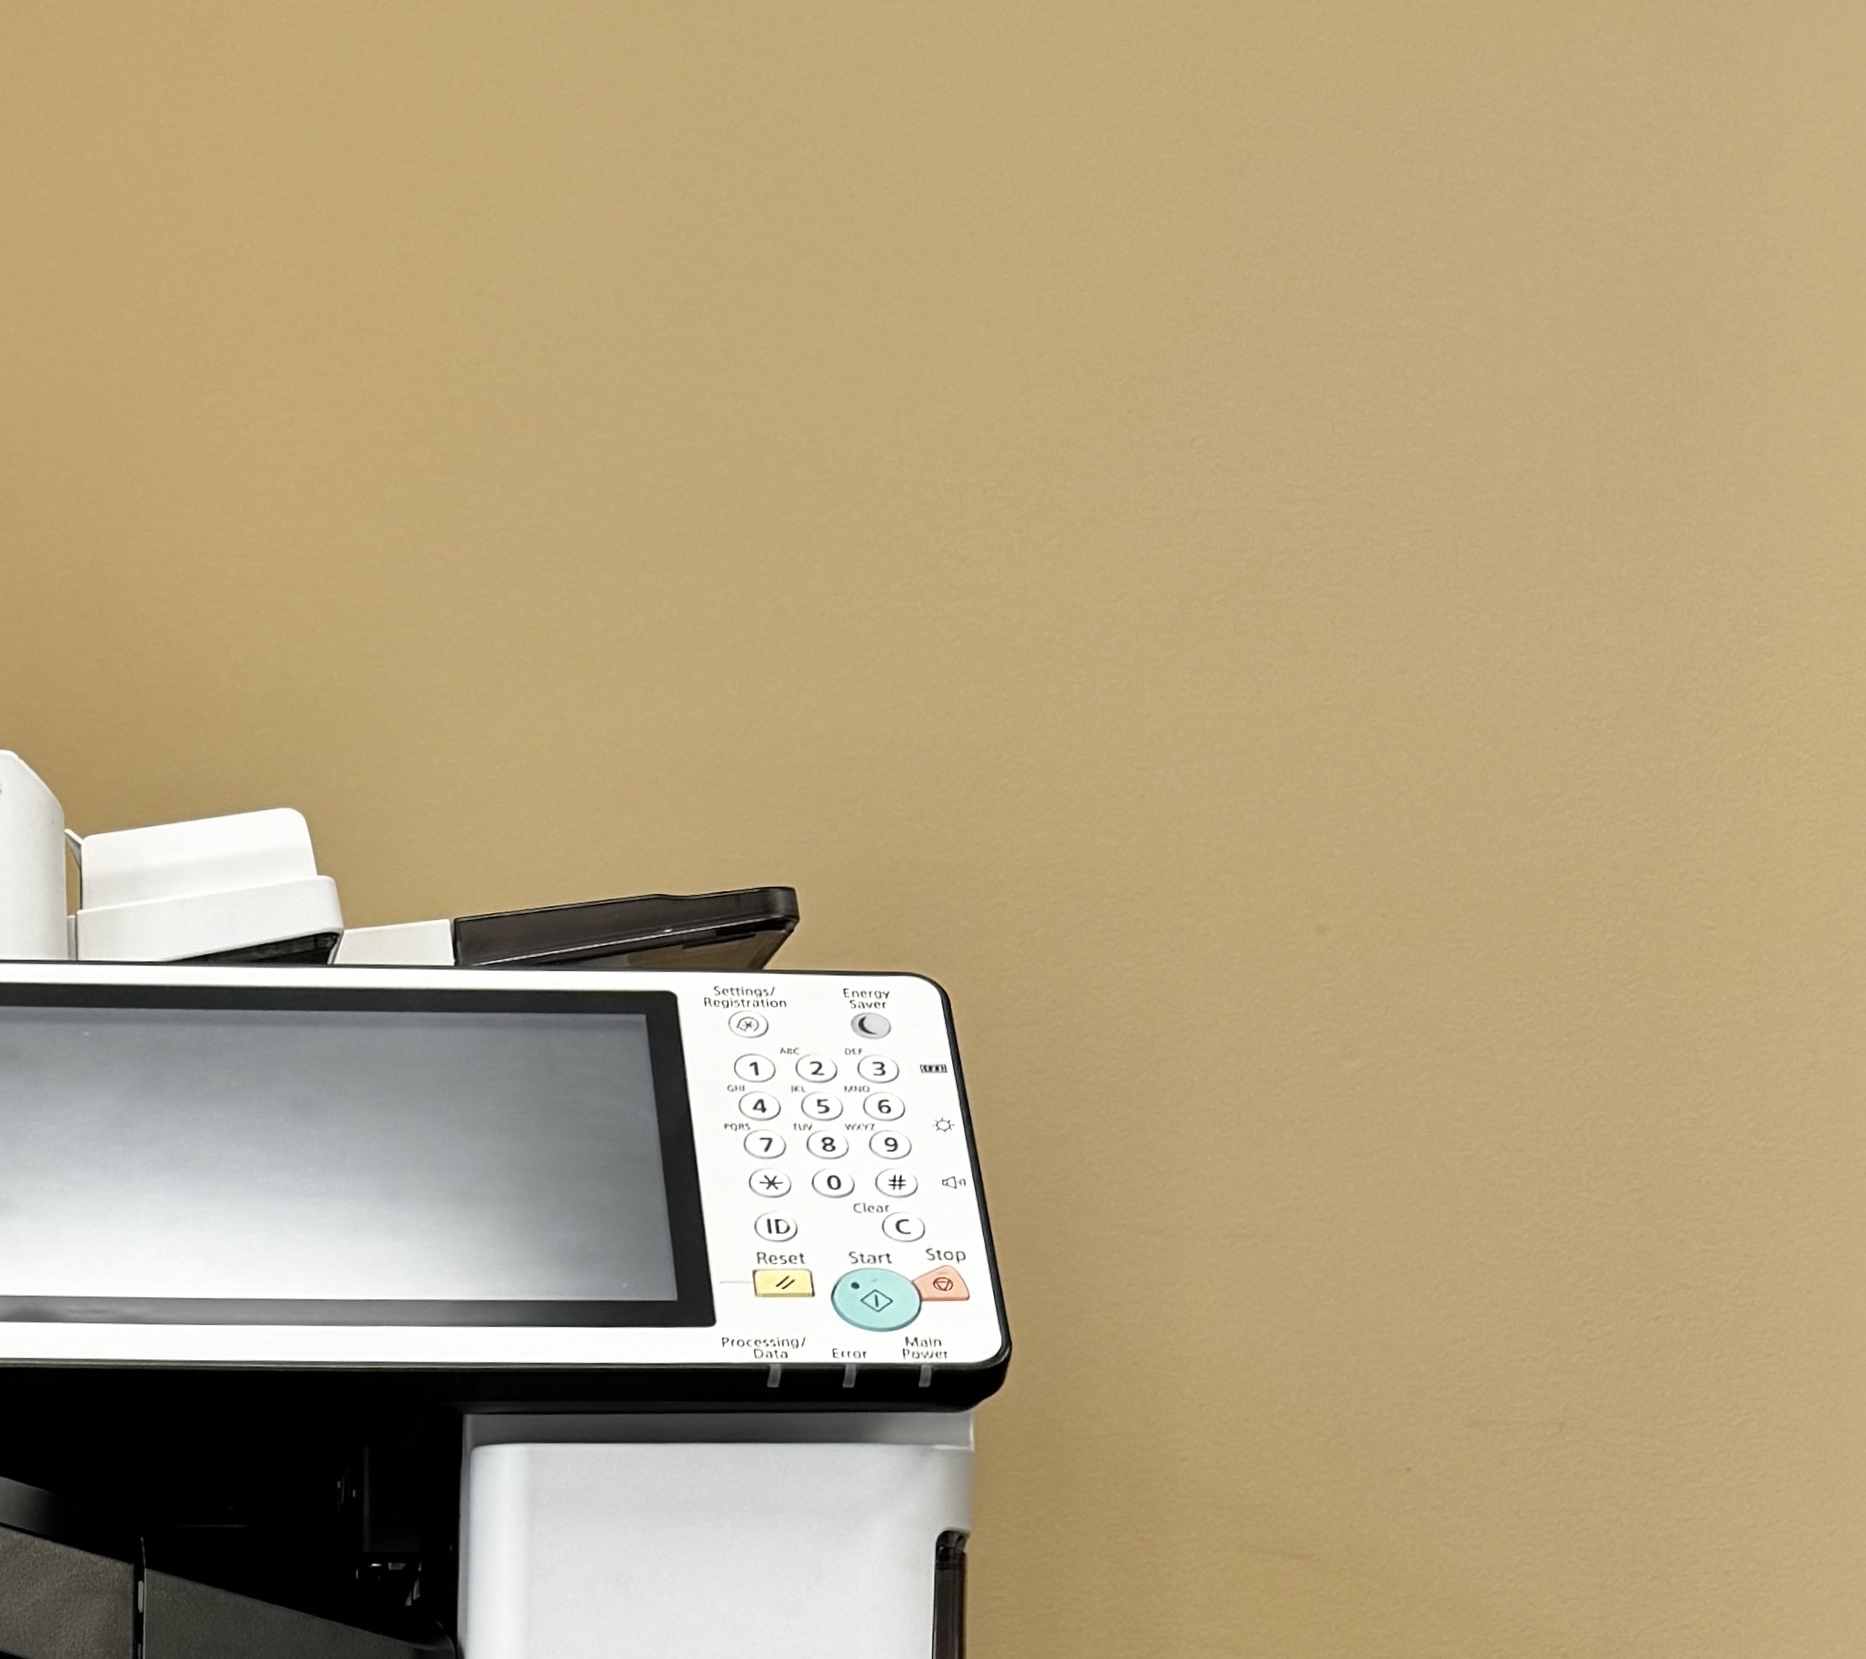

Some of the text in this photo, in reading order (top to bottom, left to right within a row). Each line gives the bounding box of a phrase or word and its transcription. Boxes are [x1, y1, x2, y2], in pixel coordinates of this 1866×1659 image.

[713, 985, 775, 998] Settings/
[842, 987, 890, 1000] Energy
[703, 996, 787, 1009] Registration
[849, 999, 886, 1009] Saver
[779, 1047, 799, 1055] ABC
[844, 1047, 862, 1056] DEF
[749, 1061, 760, 1077] 1
[809, 1060, 825, 1076] 2
[872, 1061, 887, 1077] 3
[726, 1084, 746, 1093] GHI
[843, 1085, 870, 1093] MNO
[752, 1098, 767, 1114] 4
[816, 1098, 831, 1115] 5
[877, 1098, 892, 1115] 6
[723, 1122, 751, 1132] PQRS
[793, 1122, 813, 1131] TUV
[759, 1137, 774, 1153] 7
[820, 1136, 837, 1153] 8
[884, 1136, 899, 1153] 9
[826, 1174, 842, 1191] 0
[853, 1202, 890, 1214] Clear
[766, 1218, 791, 1235] ID
[894, 1218, 912, 1235] C
[756, 1251, 805, 1265] Reset
[848, 1251, 893, 1265] Start
[925, 1247, 967, 1264] Stop
[721, 1336, 806, 1350] Processing/
[904, 1336, 942, 1347] Main
[753, 1348, 789, 1359] Data
[831, 1347, 867, 1359] Error
[902, 1347, 948, 1359] Power
